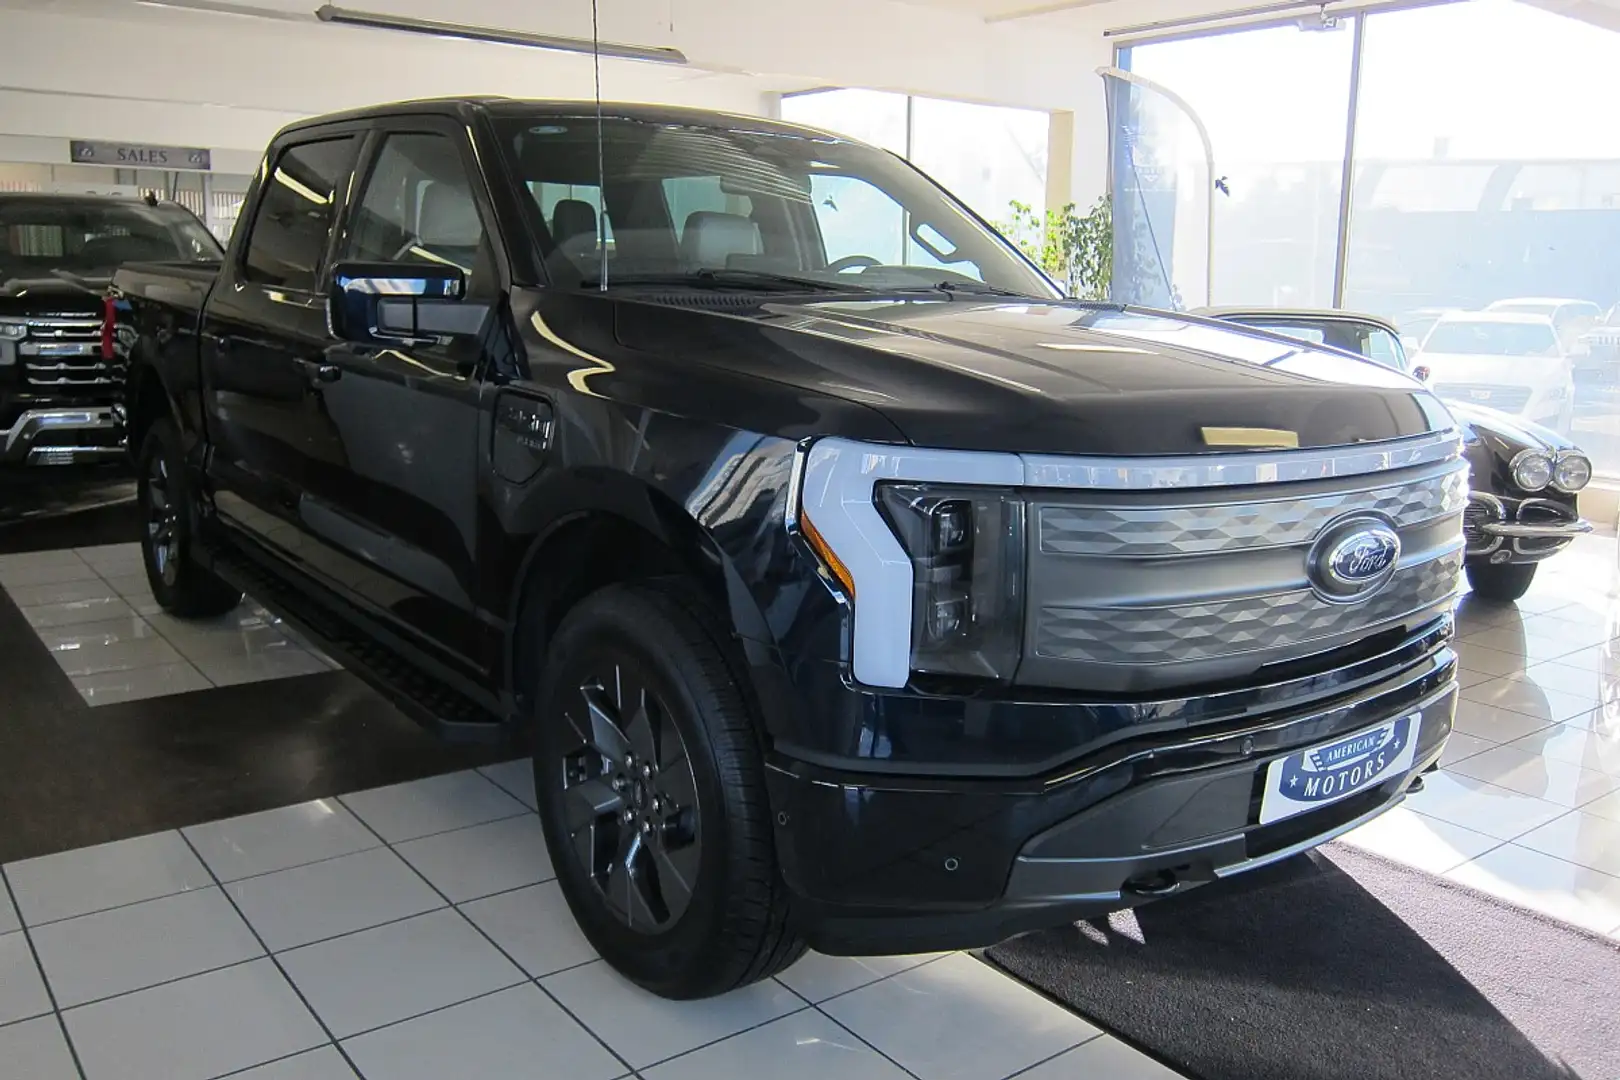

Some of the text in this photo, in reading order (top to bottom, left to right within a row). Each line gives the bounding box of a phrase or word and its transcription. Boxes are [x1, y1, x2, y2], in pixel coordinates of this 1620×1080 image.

[116, 148, 168, 163] SALES
[1348, 540, 1388, 575] Ford
[1326, 735, 1376, 763] AMERICAN
[1303, 751, 1385, 797] MOTORS
